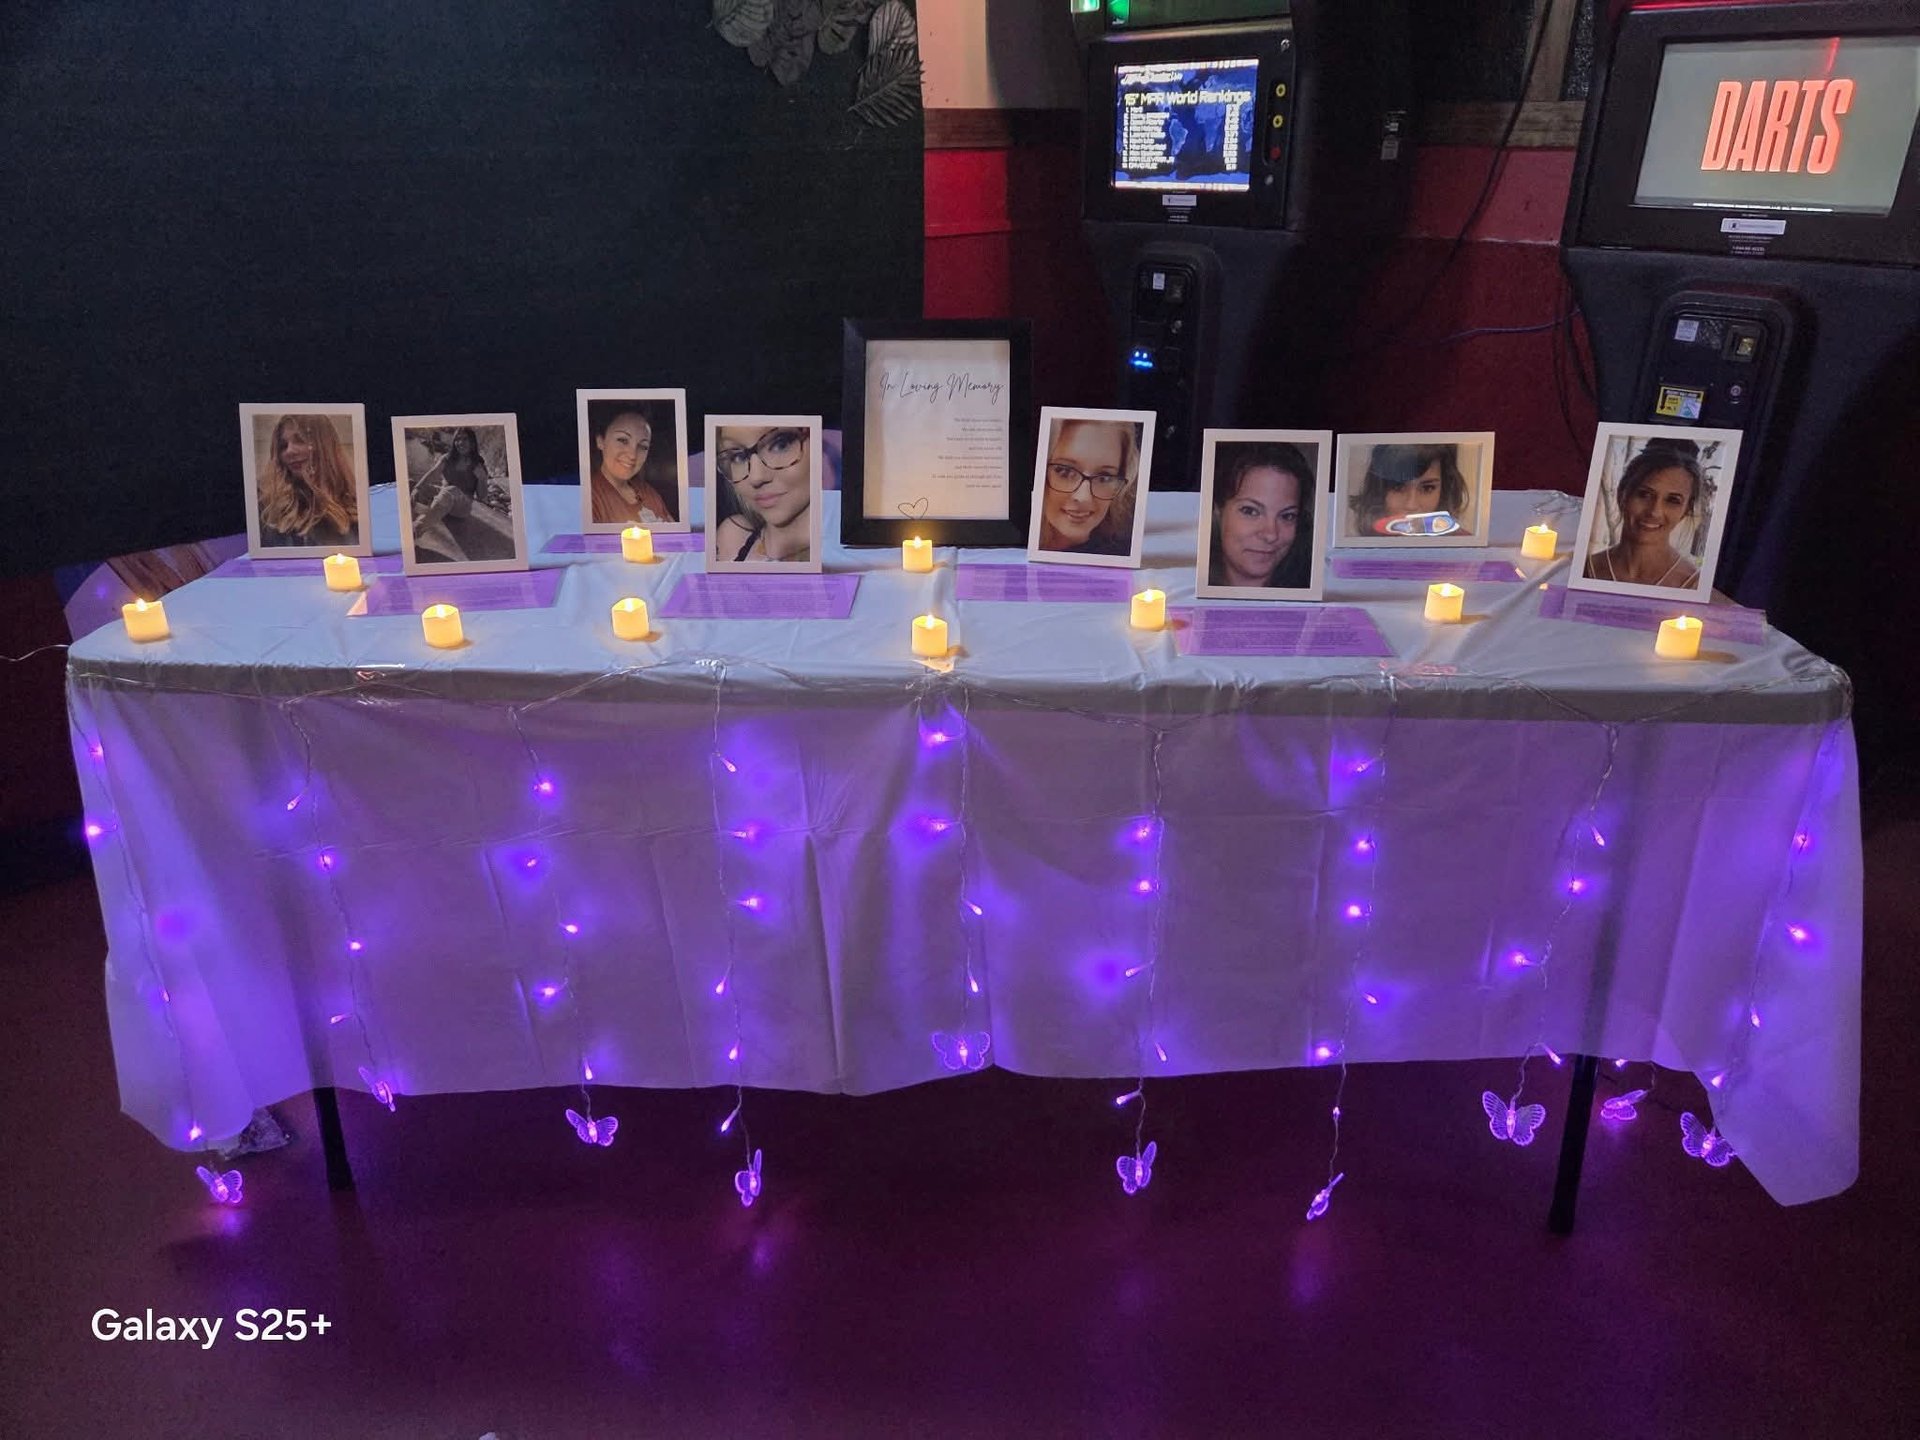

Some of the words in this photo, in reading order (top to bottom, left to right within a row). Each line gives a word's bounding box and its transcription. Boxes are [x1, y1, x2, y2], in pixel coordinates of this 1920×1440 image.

[1141, 92, 1165, 105] MPR
[1166, 91, 1198, 105] World
[1199, 89, 1251, 104] Rankings
[1701, 79, 1854, 174] DARTS
[880, 372, 897, 401] In
[900, 371, 942, 404] Loving
[946, 372, 1004, 406] Memory
